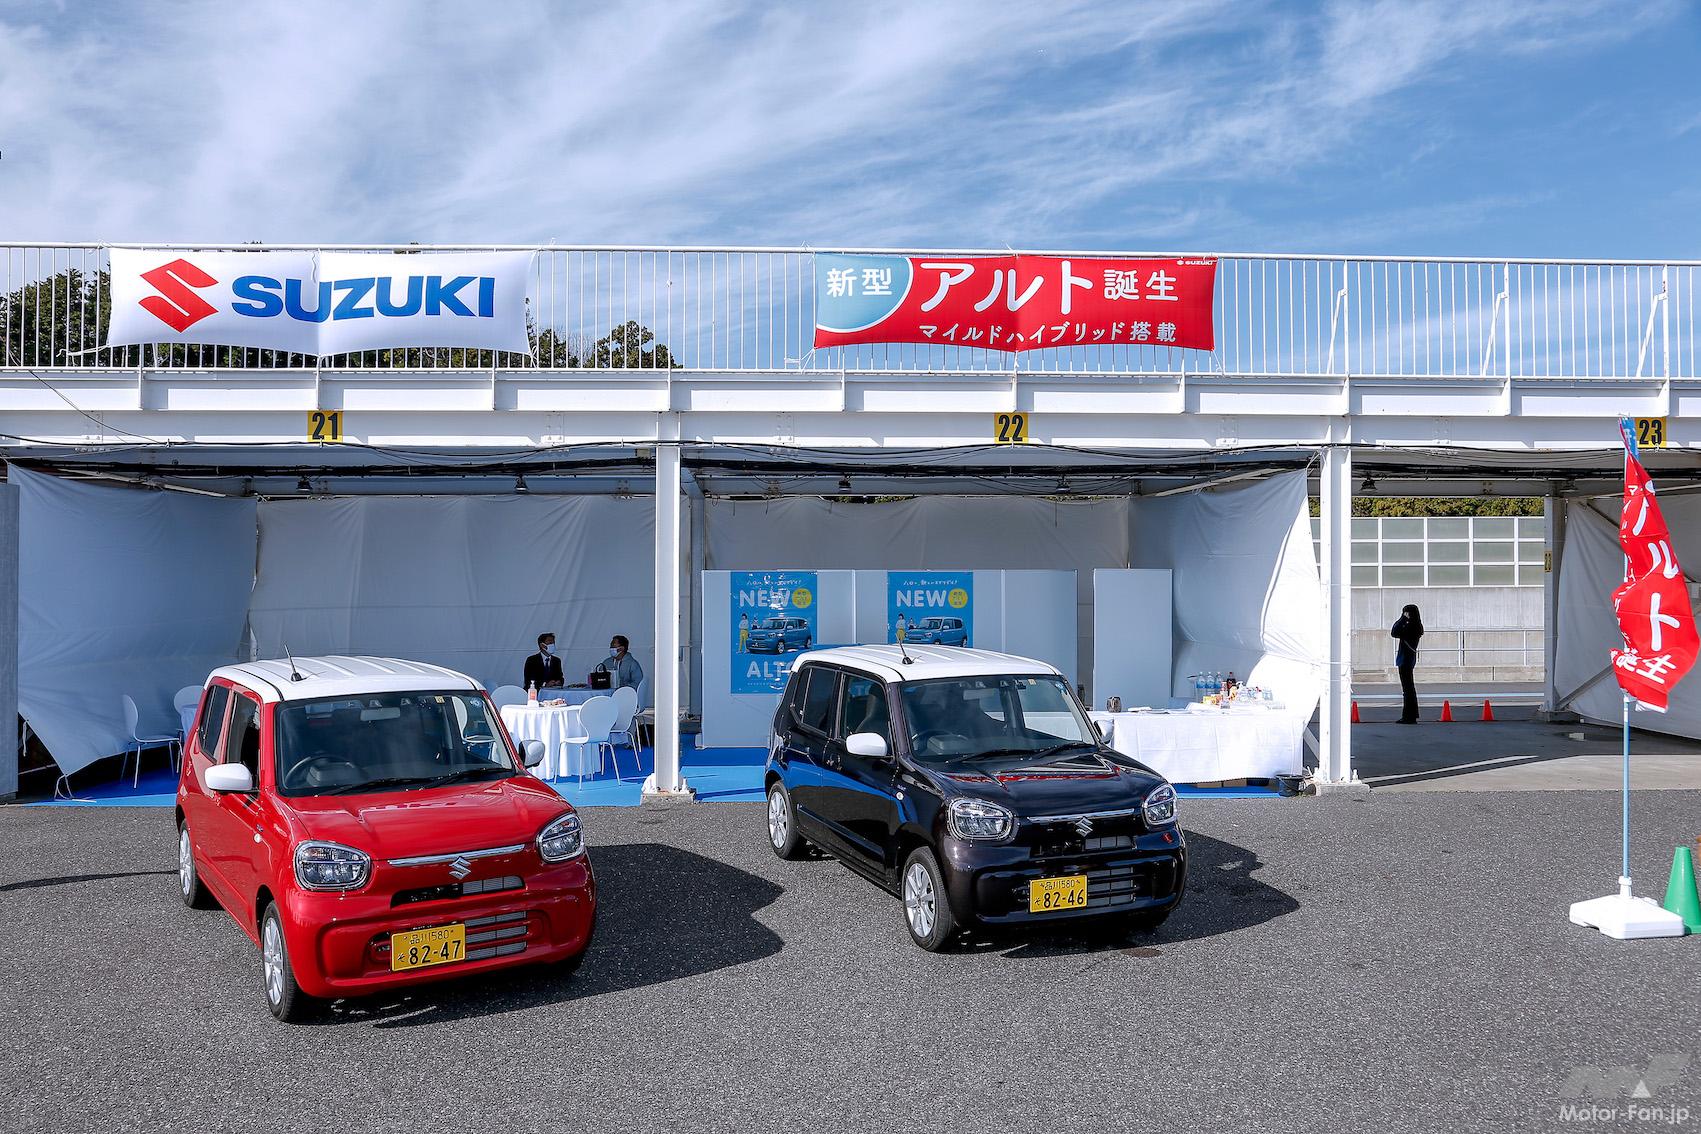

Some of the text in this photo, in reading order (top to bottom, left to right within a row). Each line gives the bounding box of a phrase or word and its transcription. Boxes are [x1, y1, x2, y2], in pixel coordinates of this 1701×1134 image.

[826, 267, 892, 298] 新型
[231, 275, 495, 323] SUZUKI
[919, 321, 1177, 344] マイルドハイブリッド搭載
[312, 412, 338, 440] 21
[998, 414, 1024, 441] 22
[1639, 419, 1663, 446] 23
[740, 589, 790, 608] NEW
[896, 589, 947, 608] NEW
[1043, 889, 1084, 908] 82-46
[409, 940, 462, 965] 82-47
